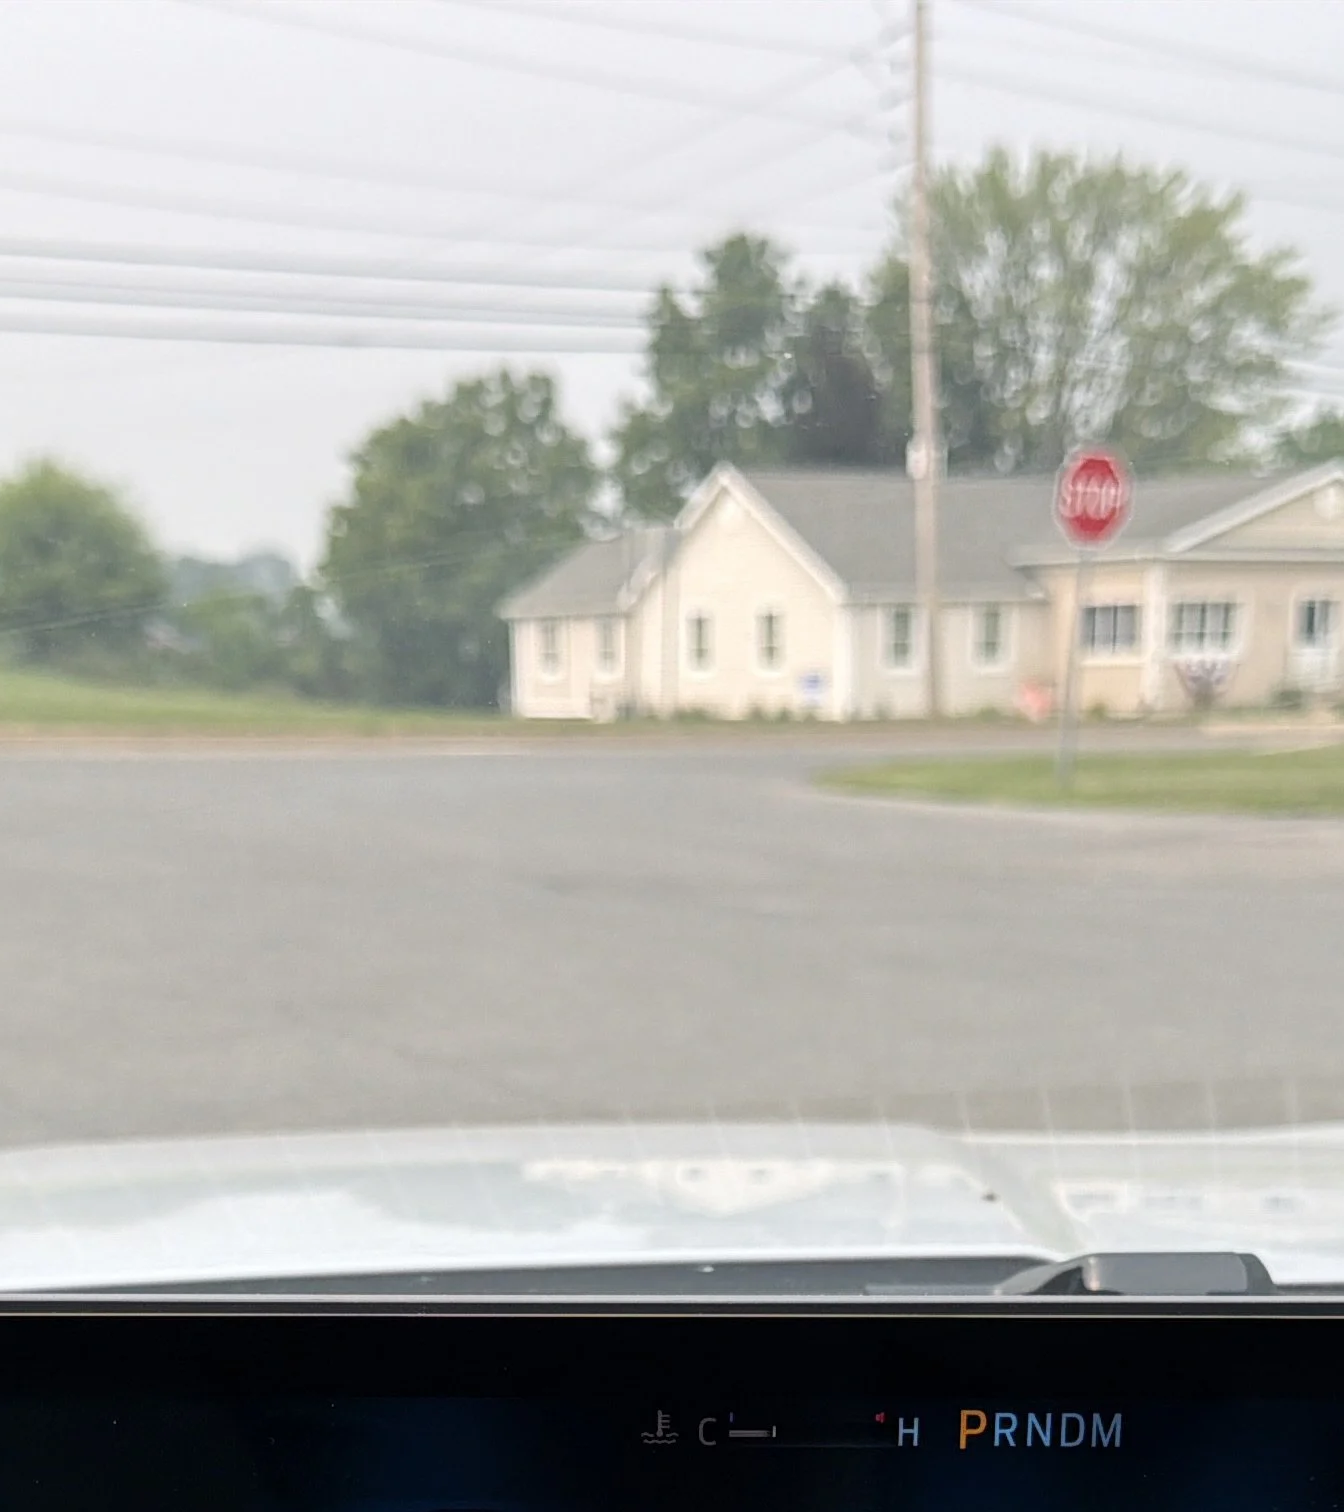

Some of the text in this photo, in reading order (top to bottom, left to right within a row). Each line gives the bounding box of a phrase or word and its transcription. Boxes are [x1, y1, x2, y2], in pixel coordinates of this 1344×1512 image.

[1060, 477, 1121, 520] STOP
[698, 1417, 718, 1446] C
[898, 1417, 920, 1446] H
